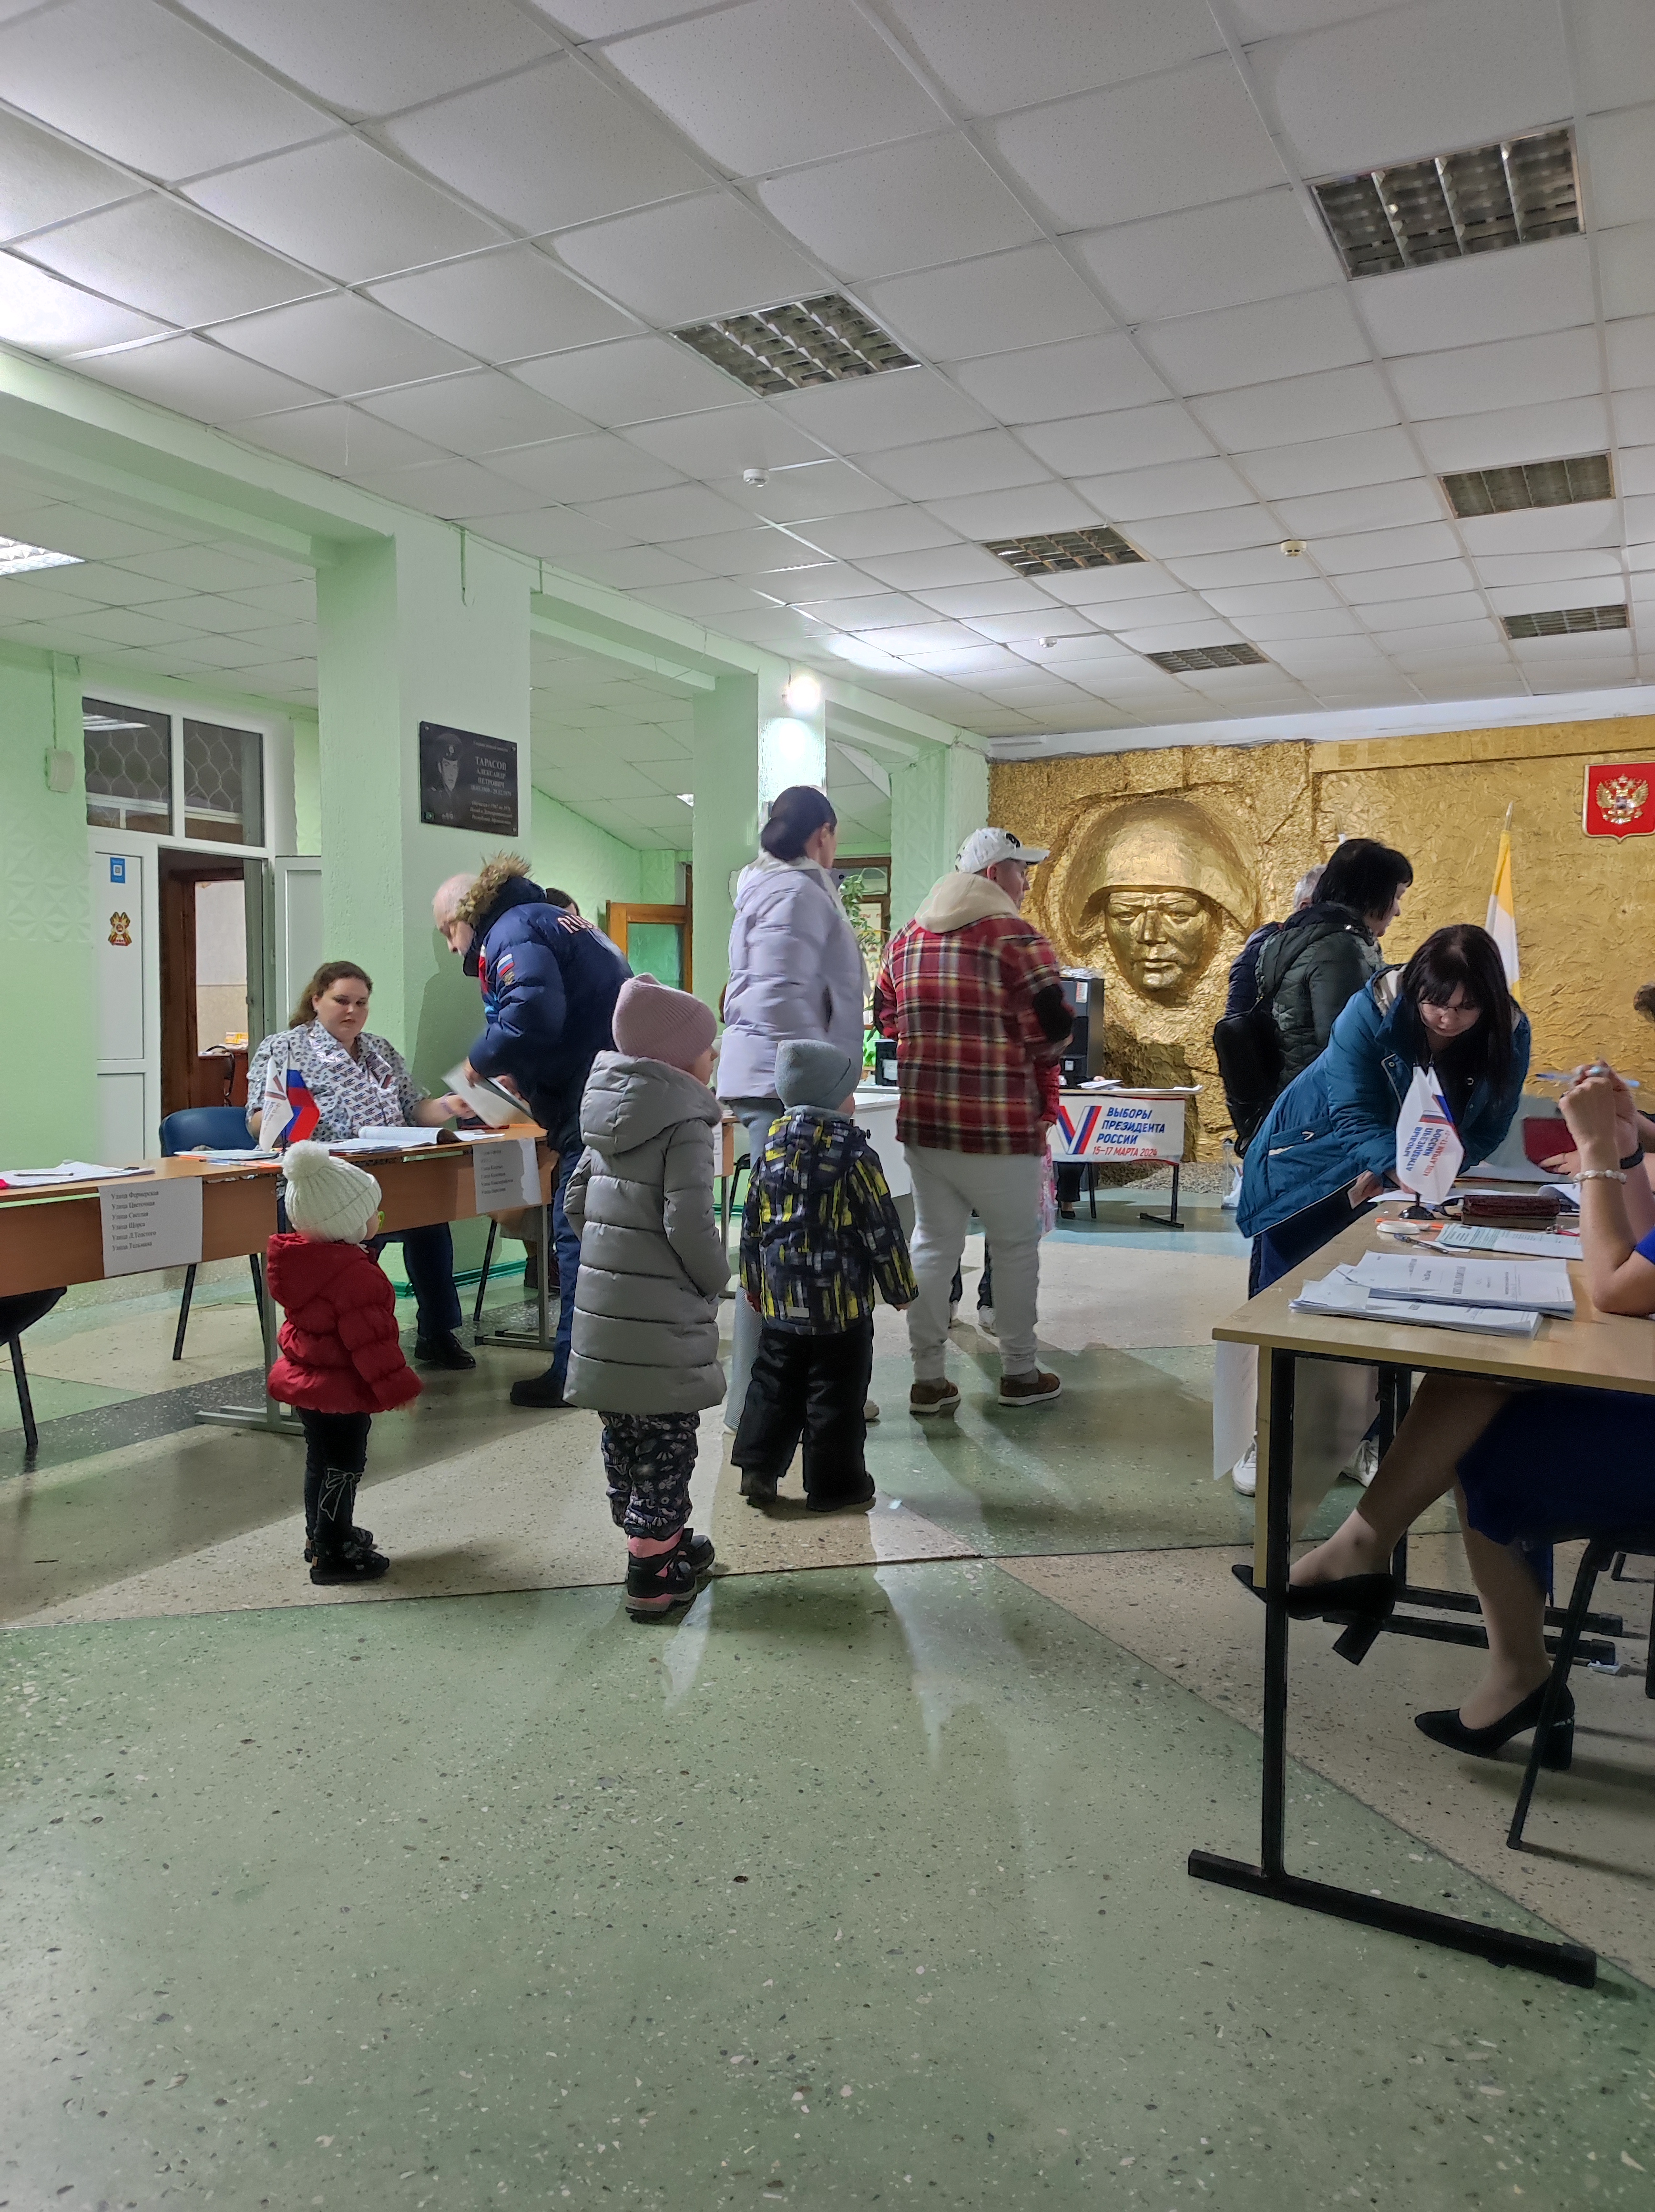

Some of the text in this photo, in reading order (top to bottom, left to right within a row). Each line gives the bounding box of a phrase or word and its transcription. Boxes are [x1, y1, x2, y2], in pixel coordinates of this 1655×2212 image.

[476, 756, 506, 770] ТАРАСОВ
[1106, 1107, 1153, 1119] ВЫБОРЫ
[1101, 1120, 1165, 1133] ПРЕЗИДЕНТА
[1096, 1133, 1139, 1145] РОССИИ
[1113, 1147, 1138, 1157] МАРТА
[1140, 1148, 1157, 1157] 2024
